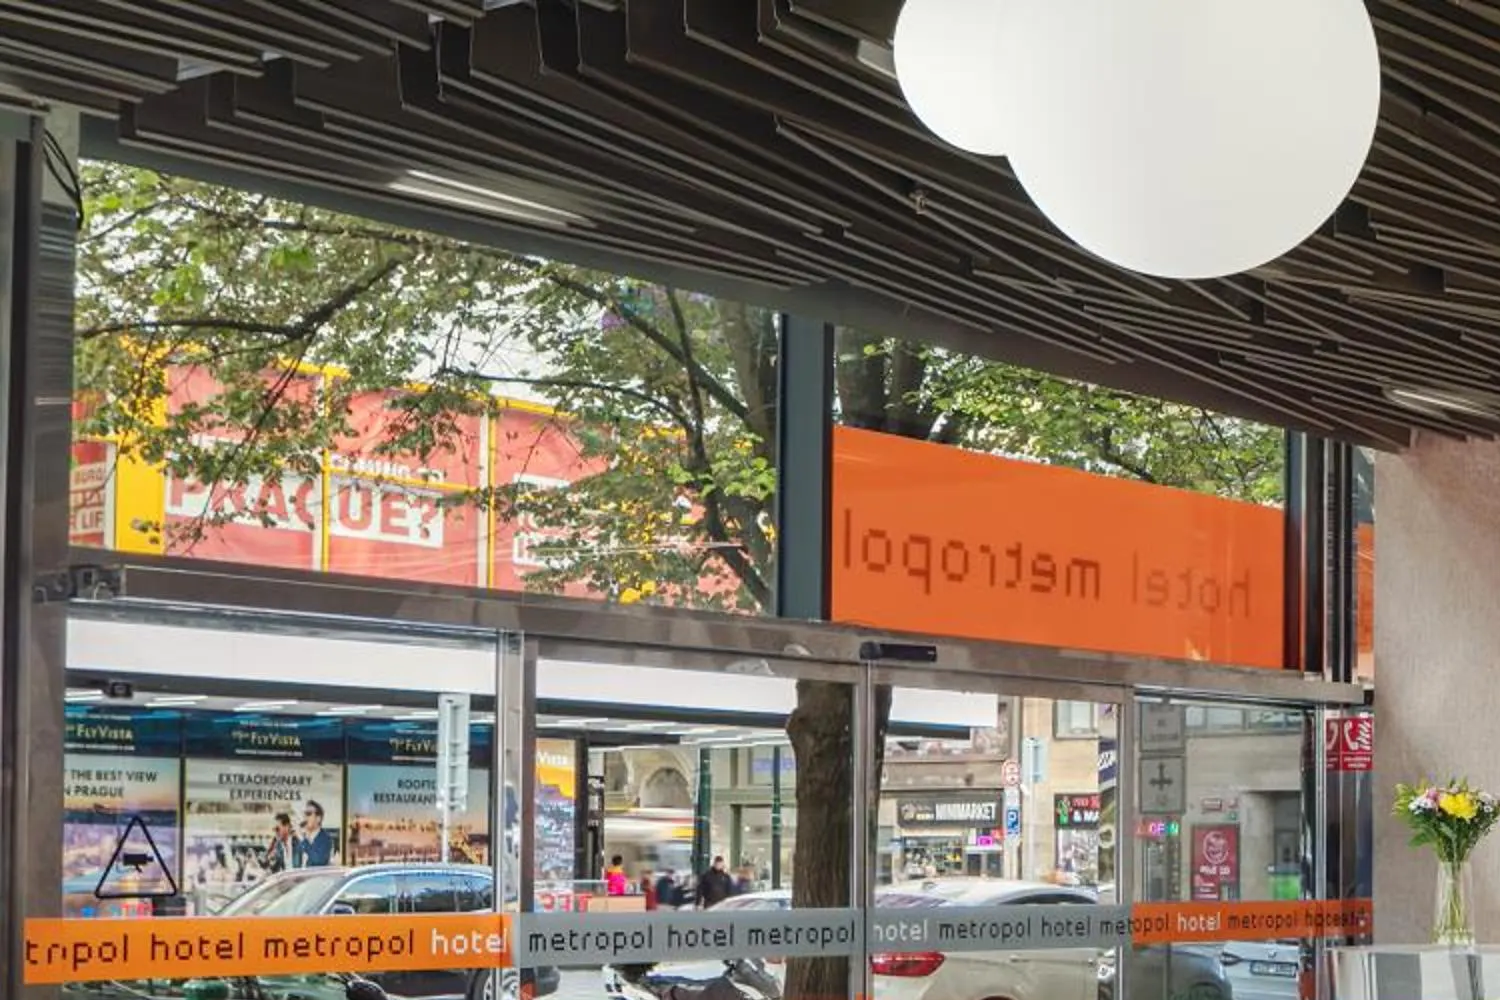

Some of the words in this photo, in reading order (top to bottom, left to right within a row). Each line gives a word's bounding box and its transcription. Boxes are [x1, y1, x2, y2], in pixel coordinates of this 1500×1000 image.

[169, 472, 440, 540] PRAGUE?
[95, 769, 123, 781] BEST
[126, 770, 158, 782] VIEW
[218, 773, 313, 785] EXTRAORDINARY
[74, 785, 125, 798] PRAGUE
[229, 789, 302, 801] EXPERIENCES
[935, 803, 997, 821] MINIMARKET
[938, 916, 1032, 945] metropol
[1041, 916, 1092, 938] hotel
[1177, 911, 1221, 933] hotel
[1227, 911, 1297, 931] metropol
[150, 932, 244, 961] hotel
[263, 928, 415, 963] metropol
[430, 928, 508, 956] hotel
[528, 924, 653, 956] metropol
[667, 924, 735, 949] hotel
[747, 919, 856, 949] metropol
